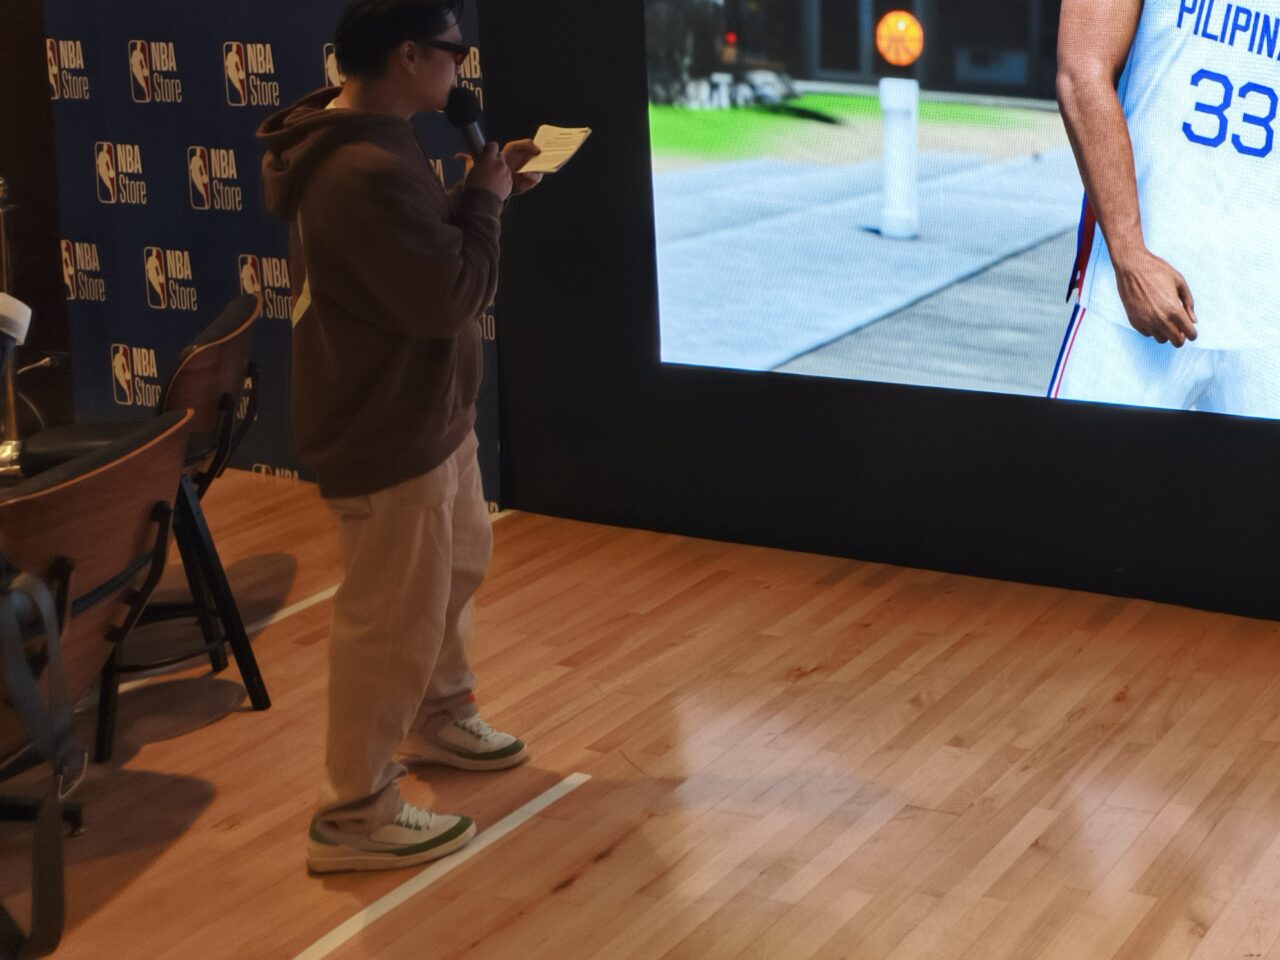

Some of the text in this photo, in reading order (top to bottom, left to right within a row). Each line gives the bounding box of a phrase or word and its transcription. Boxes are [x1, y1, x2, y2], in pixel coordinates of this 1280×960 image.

[59, 40, 84, 69] NBA
[150, 41, 177, 72] NBA
[246, 43, 275, 74] NBA
[61, 70, 90, 100] Store
[152, 72, 183, 104] Store
[249, 74, 280, 107] Store
[1182, 69, 1279, 158] 33
[116, 143, 143, 175] NBA
[210, 148, 238, 180] NBA
[118, 174, 148, 205] Store
[212, 179, 243, 211] Store
[74, 241, 100, 272] NBA
[165, 249, 193, 281] NBA
[261, 256, 291, 288] NBA
[77, 271, 106, 302] Store
[168, 280, 198, 311] Store
[131, 346, 158, 378] NBA
